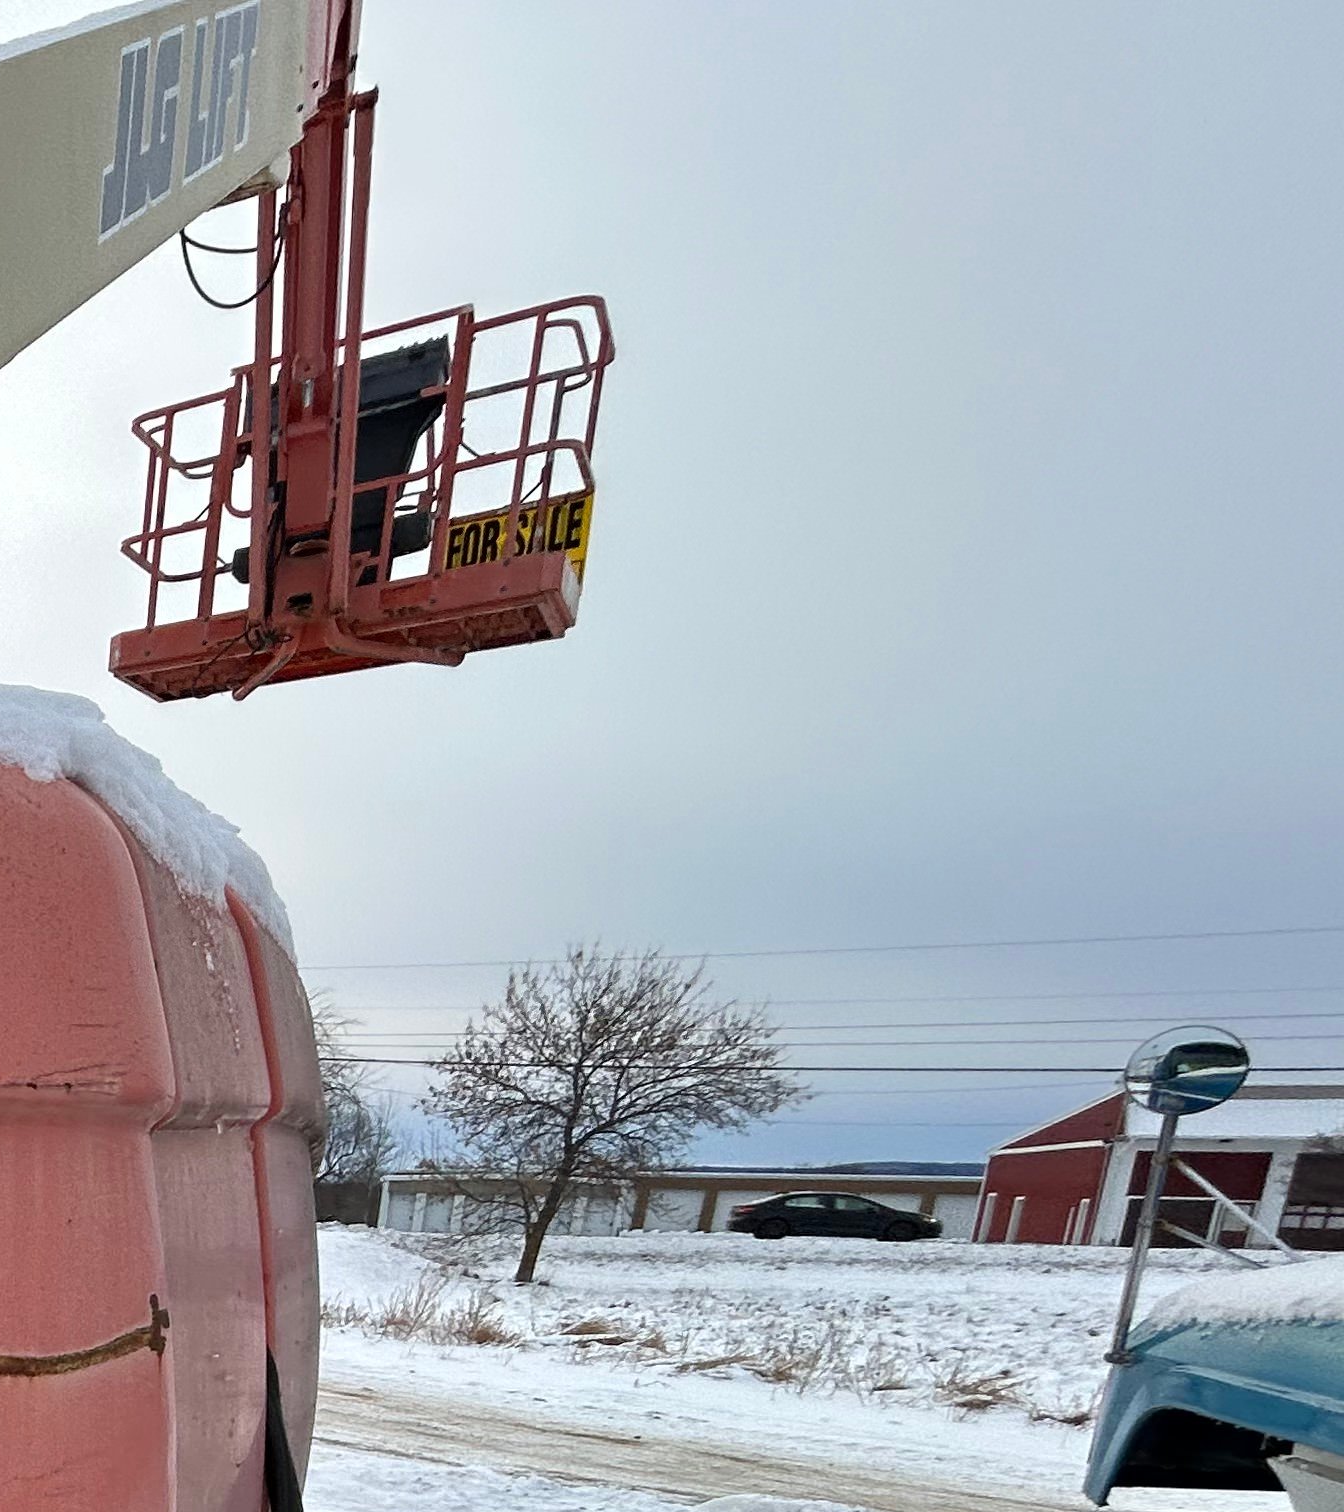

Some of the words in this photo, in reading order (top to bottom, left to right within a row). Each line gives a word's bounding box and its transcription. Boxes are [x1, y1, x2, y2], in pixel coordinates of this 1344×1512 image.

[99, 24, 184, 244] JLG
[183, 1, 260, 187] LIFT
[446, 520, 500, 569] FOR
